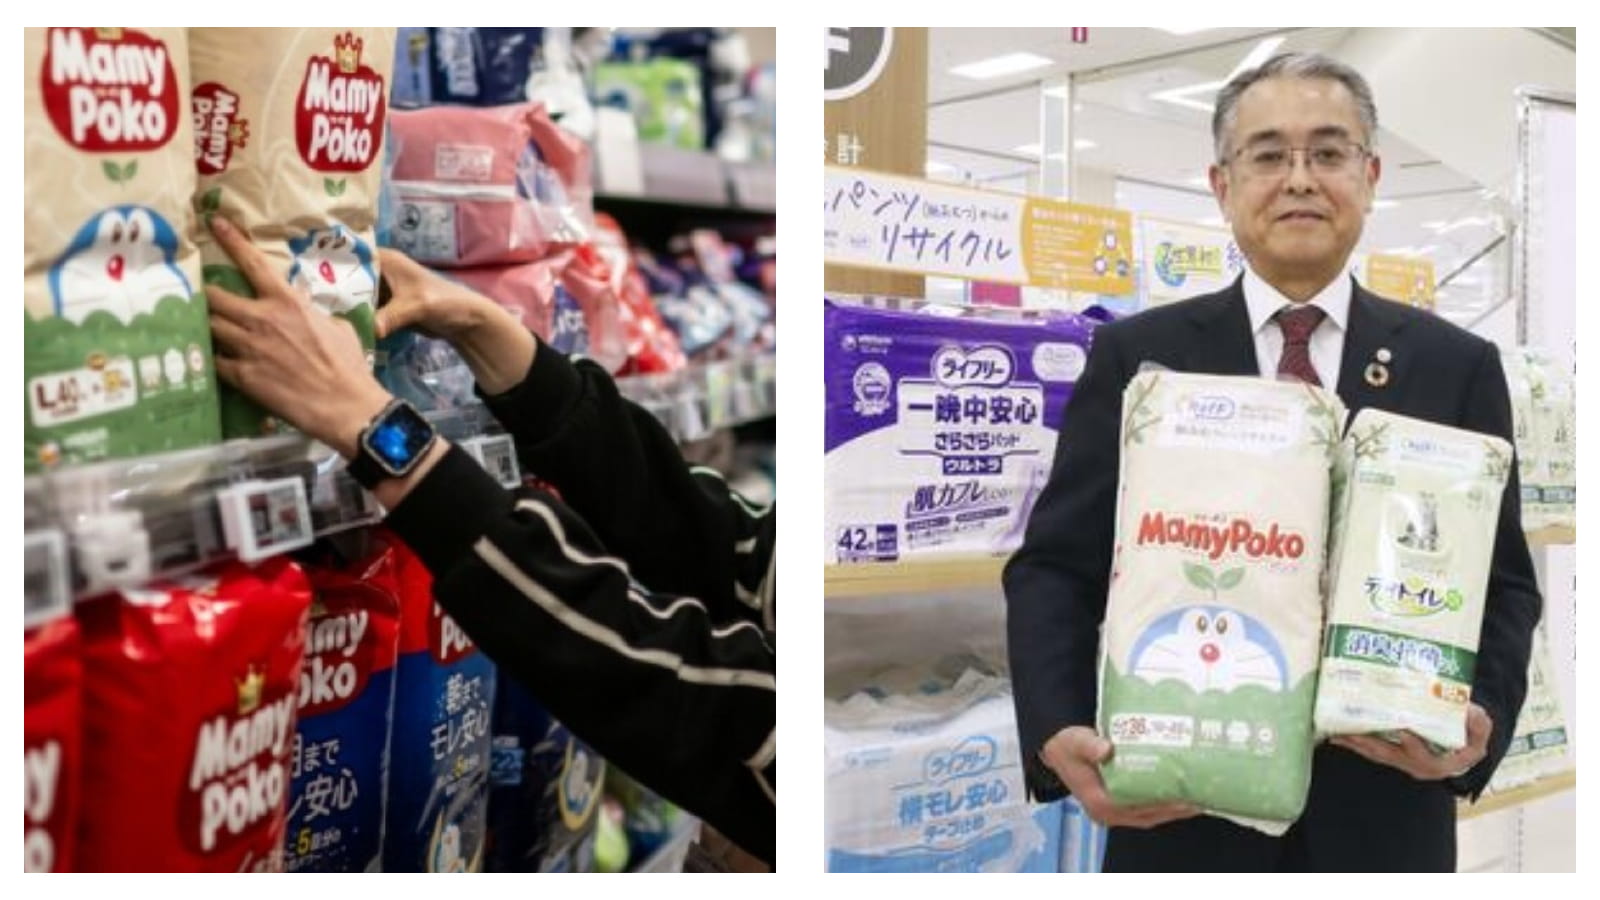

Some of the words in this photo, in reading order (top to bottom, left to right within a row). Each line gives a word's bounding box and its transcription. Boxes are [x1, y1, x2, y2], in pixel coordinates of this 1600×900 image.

[51, 28, 165, 96] Mamy
[69, 87, 168, 144] Poko
[304, 62, 384, 124] Mamy
[203, 90, 237, 169] Mamy
[308, 112, 372, 163] Poko
[882, 222, 1012, 266] リサイクル
[942, 358, 1005, 380] ライフリー
[907, 395, 1037, 424] 一晩中安心
[946, 458, 1001, 473] ウルトラ
[1137, 512, 1305, 559] MamyPoko
[190, 693, 294, 791] Mamy
[202, 761, 284, 851] Poko
